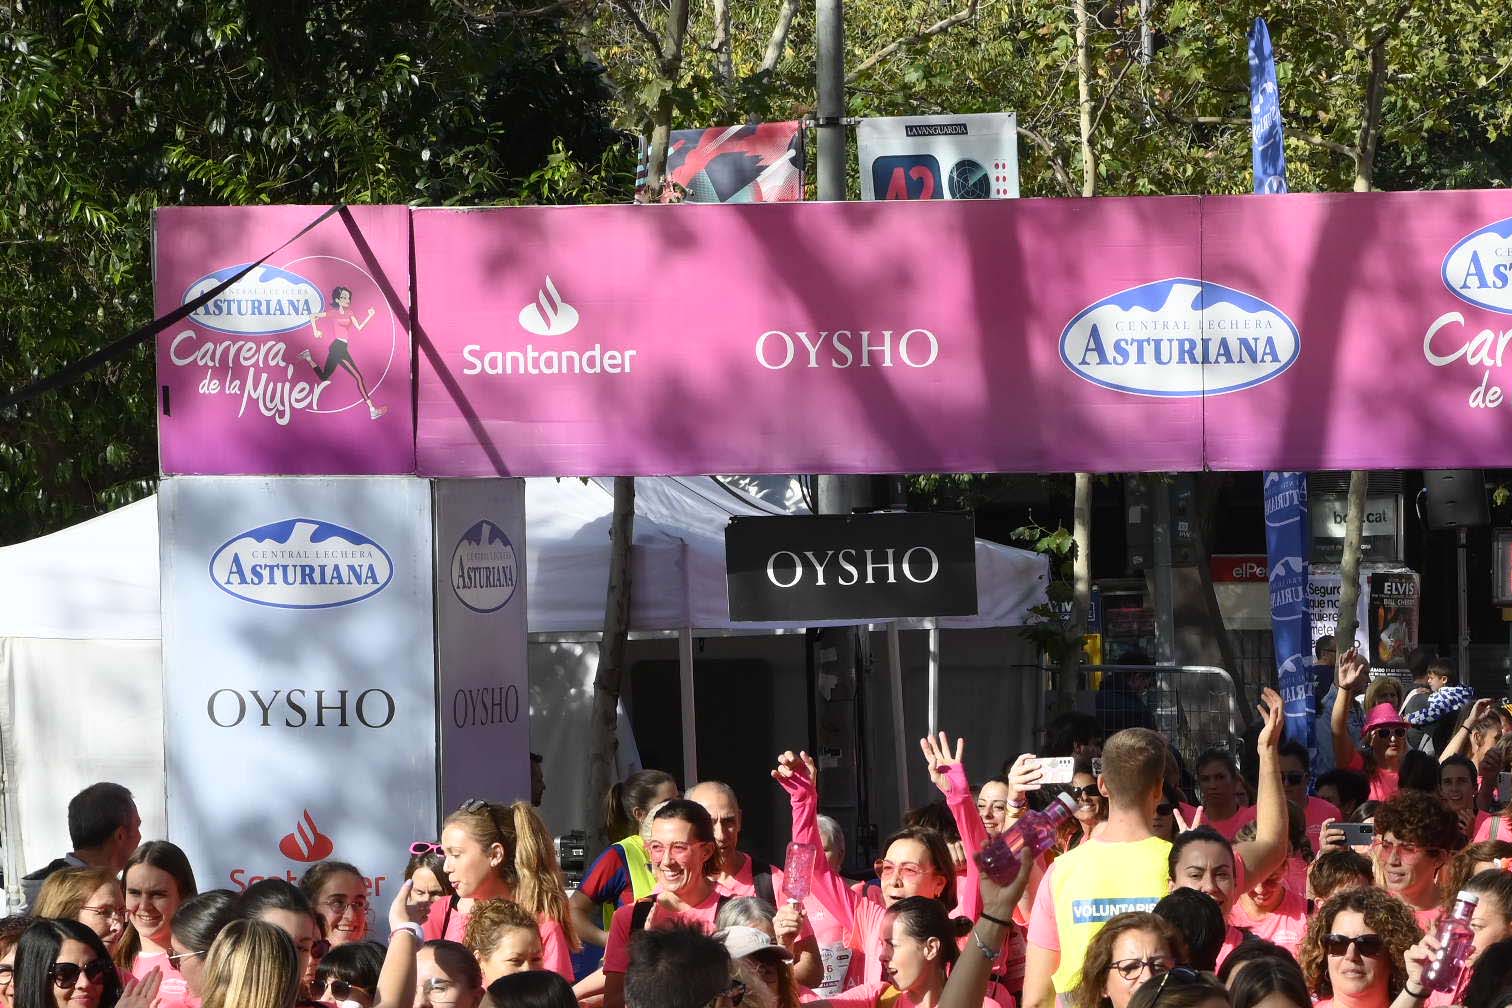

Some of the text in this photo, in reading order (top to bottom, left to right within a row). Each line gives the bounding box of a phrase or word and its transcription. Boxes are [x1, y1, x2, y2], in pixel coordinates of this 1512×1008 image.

[918, 124, 968, 136] VANGUARDIA
[1115, 318, 1273, 331] CENTRAL LECHERA
[169, 329, 288, 368] Carrera
[462, 342, 637, 376] Santander
[755, 329, 939, 370] OYSHO
[1078, 323, 1282, 366] ASTURIANA
[198, 364, 332, 426] de la Mujer
[1468, 370, 1504, 410] de
[224, 551, 380, 586] ASTURIANA
[251, 549, 374, 560] CENTRAL LECHERA
[455, 554, 515, 590] ASTURIANA
[766, 546, 939, 588] OYSHO
[1383, 582, 1415, 595] ELVIS
[206, 688, 396, 729] OYSHO
[453, 683, 519, 729] OYSHO
